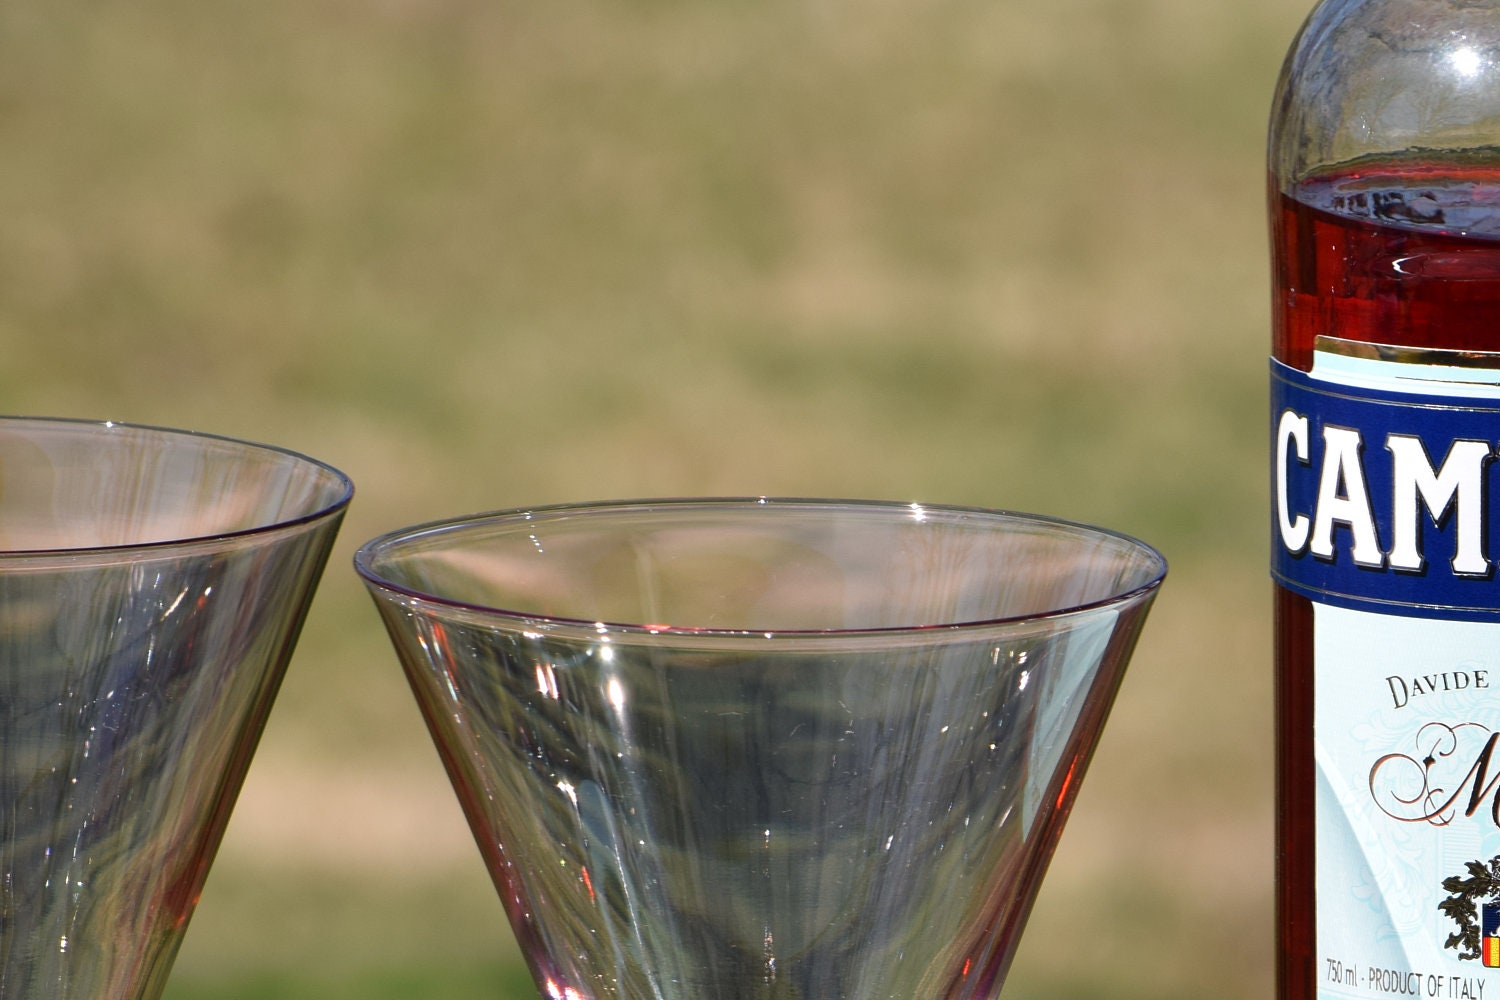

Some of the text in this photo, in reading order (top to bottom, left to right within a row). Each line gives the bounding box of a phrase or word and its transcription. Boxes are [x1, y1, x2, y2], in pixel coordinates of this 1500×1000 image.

[1386, 670, 1490, 709] DAVIDE
[1327, 958, 1486, 1000] 750 ml PRODUCT OF ITALY
